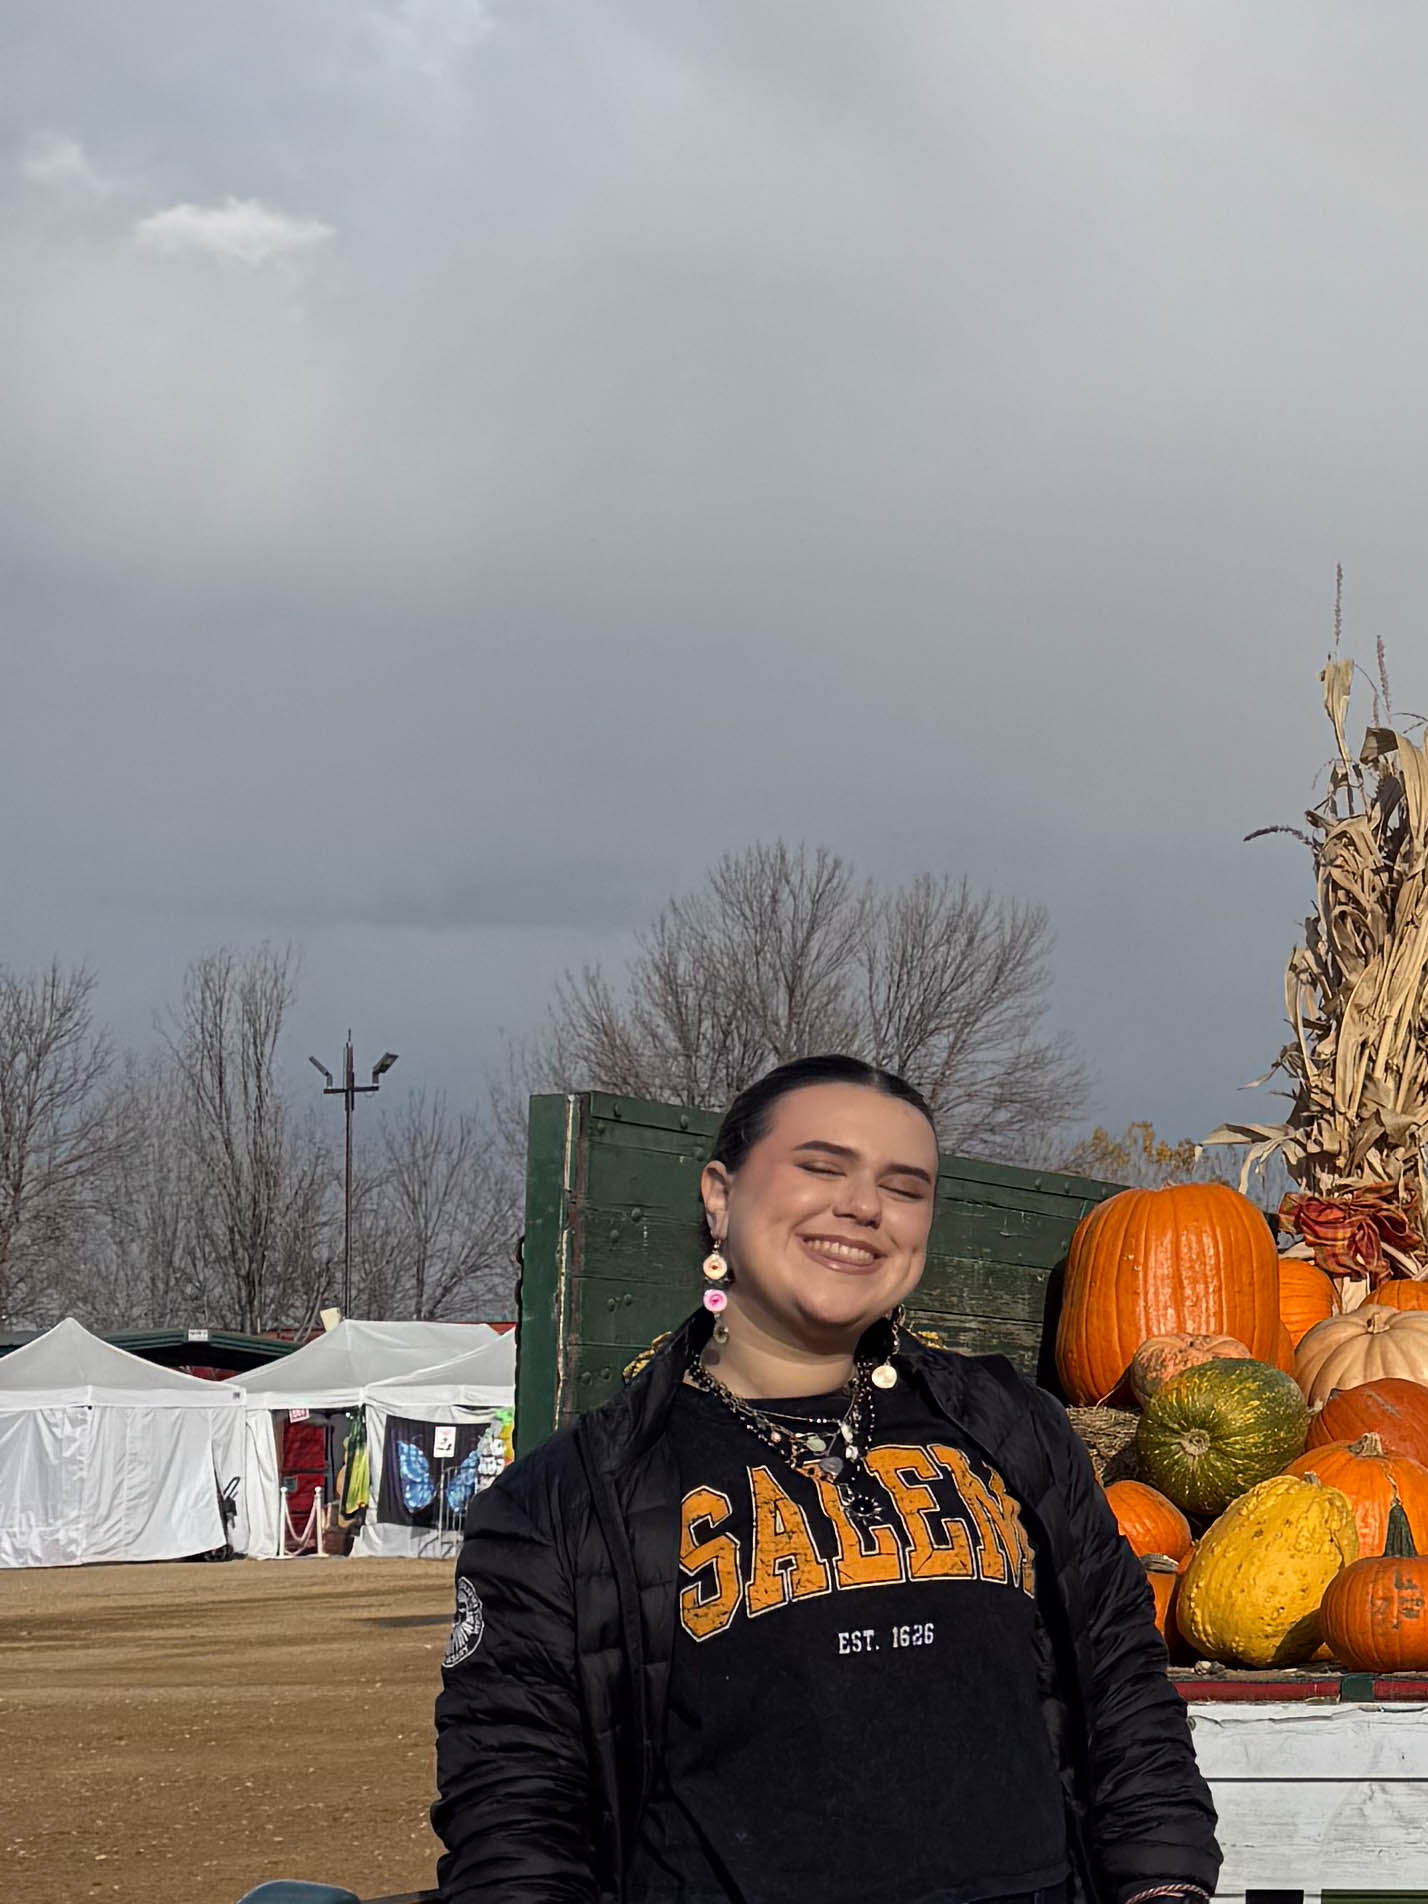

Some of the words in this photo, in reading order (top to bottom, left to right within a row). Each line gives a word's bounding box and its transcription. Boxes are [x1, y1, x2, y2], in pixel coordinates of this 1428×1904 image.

[679, 1443, 1035, 1642] SALEM
[838, 1629, 880, 1655] EST.
[892, 1622, 935, 1649] 1626
